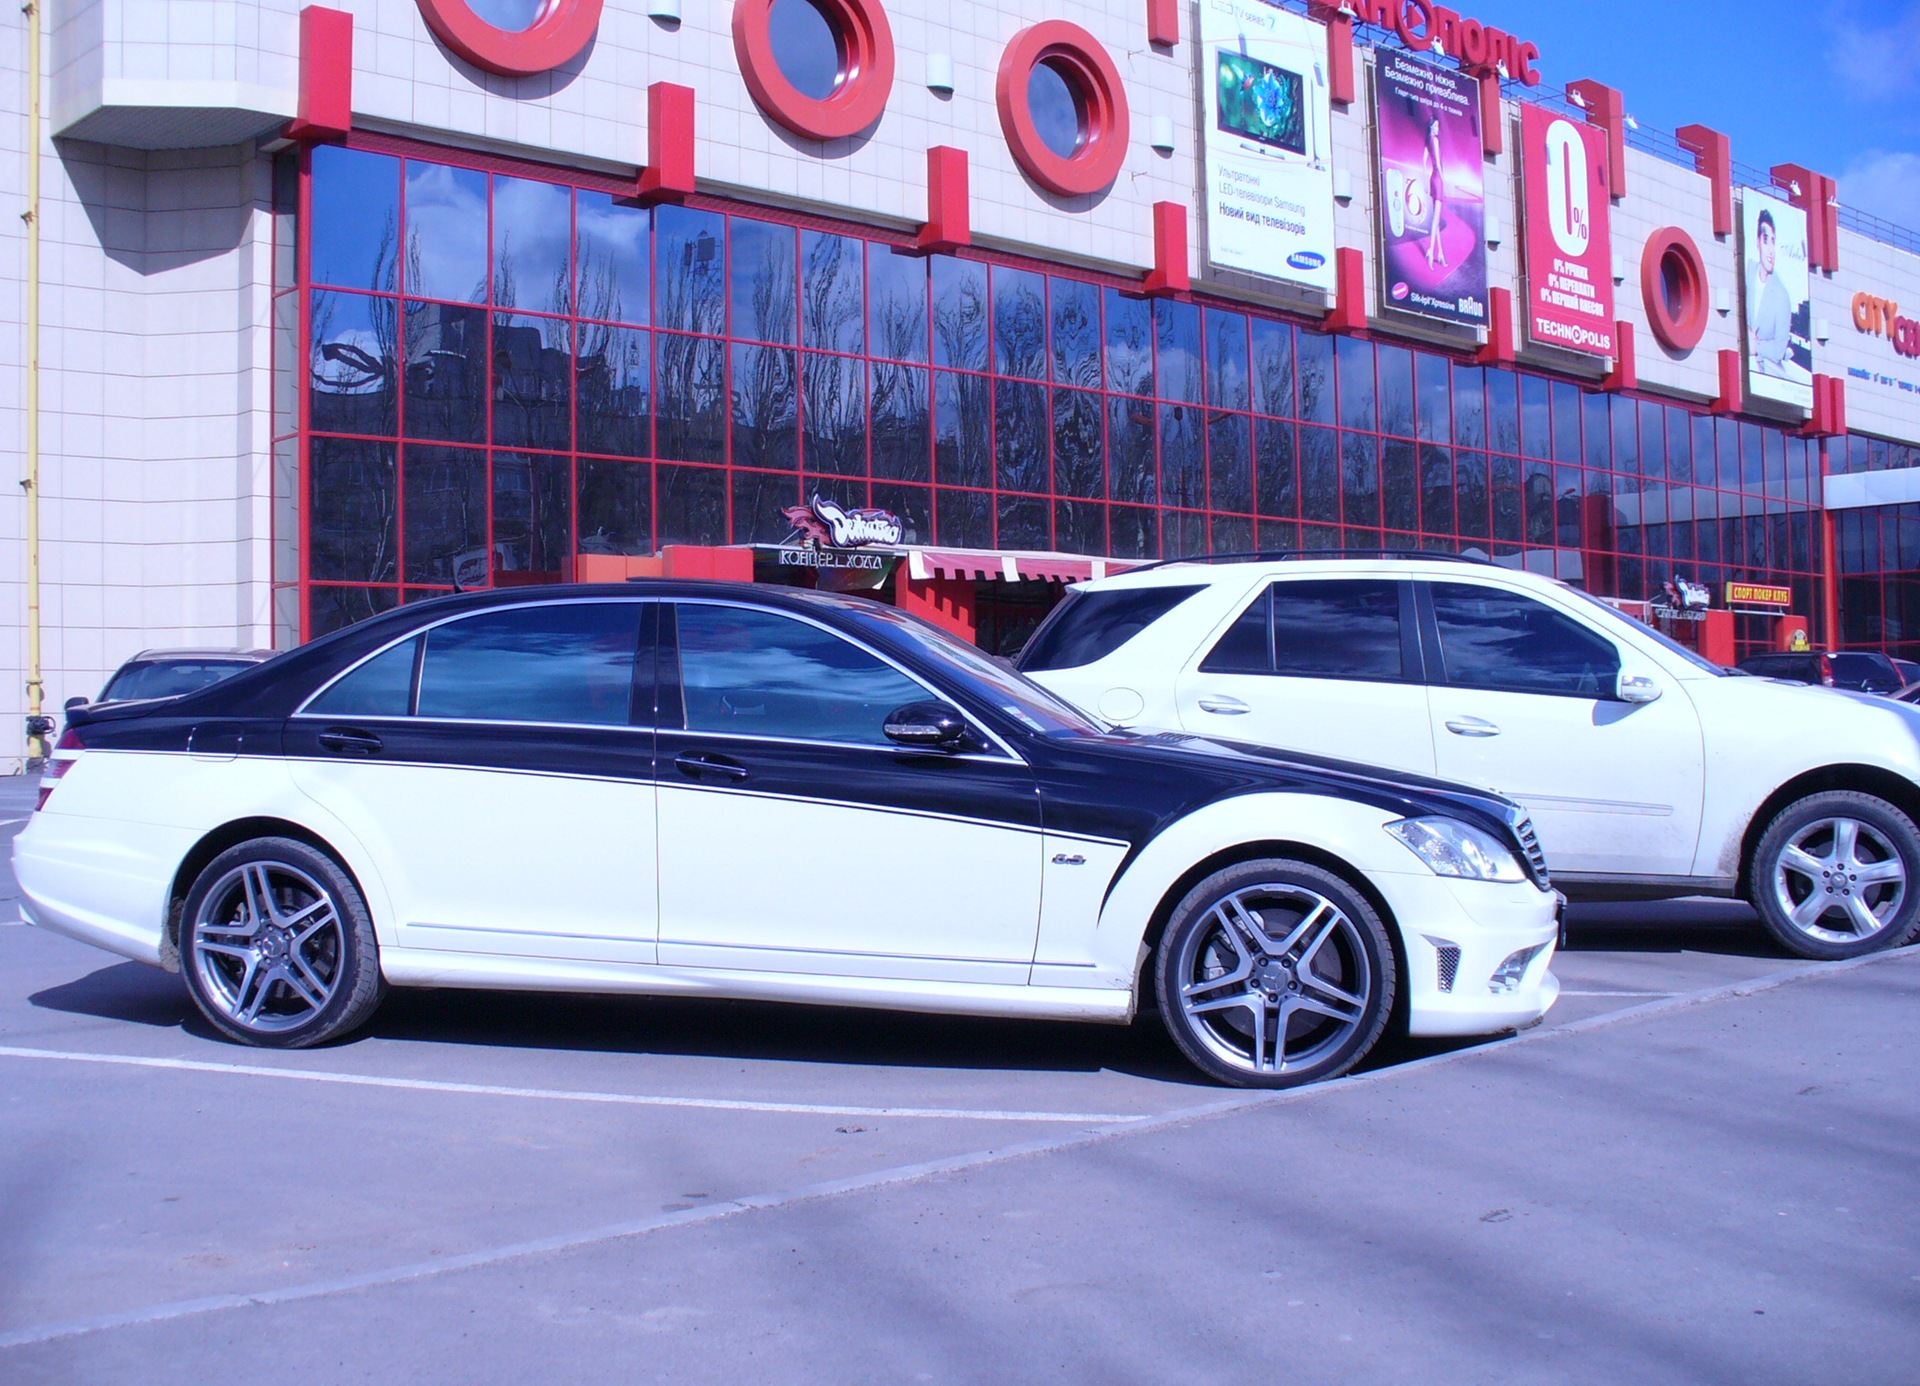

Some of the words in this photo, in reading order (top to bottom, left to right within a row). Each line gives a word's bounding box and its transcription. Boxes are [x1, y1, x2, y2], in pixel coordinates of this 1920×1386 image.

[1219, 201, 1244, 220] Новий
[1245, 210, 1260, 226] вид
[1262, 215, 1306, 236] телевізорів
[1274, 196, 1306, 217] Samsung
[1851, 291, 1898, 342] CITY
[1536, 317, 1611, 349] TECHNOPOLIS
[1734, 586, 1753, 600] СПОРТ
[1753, 588, 1772, 601] ПОКЕР
[1773, 590, 1788, 603] КЛУБ
